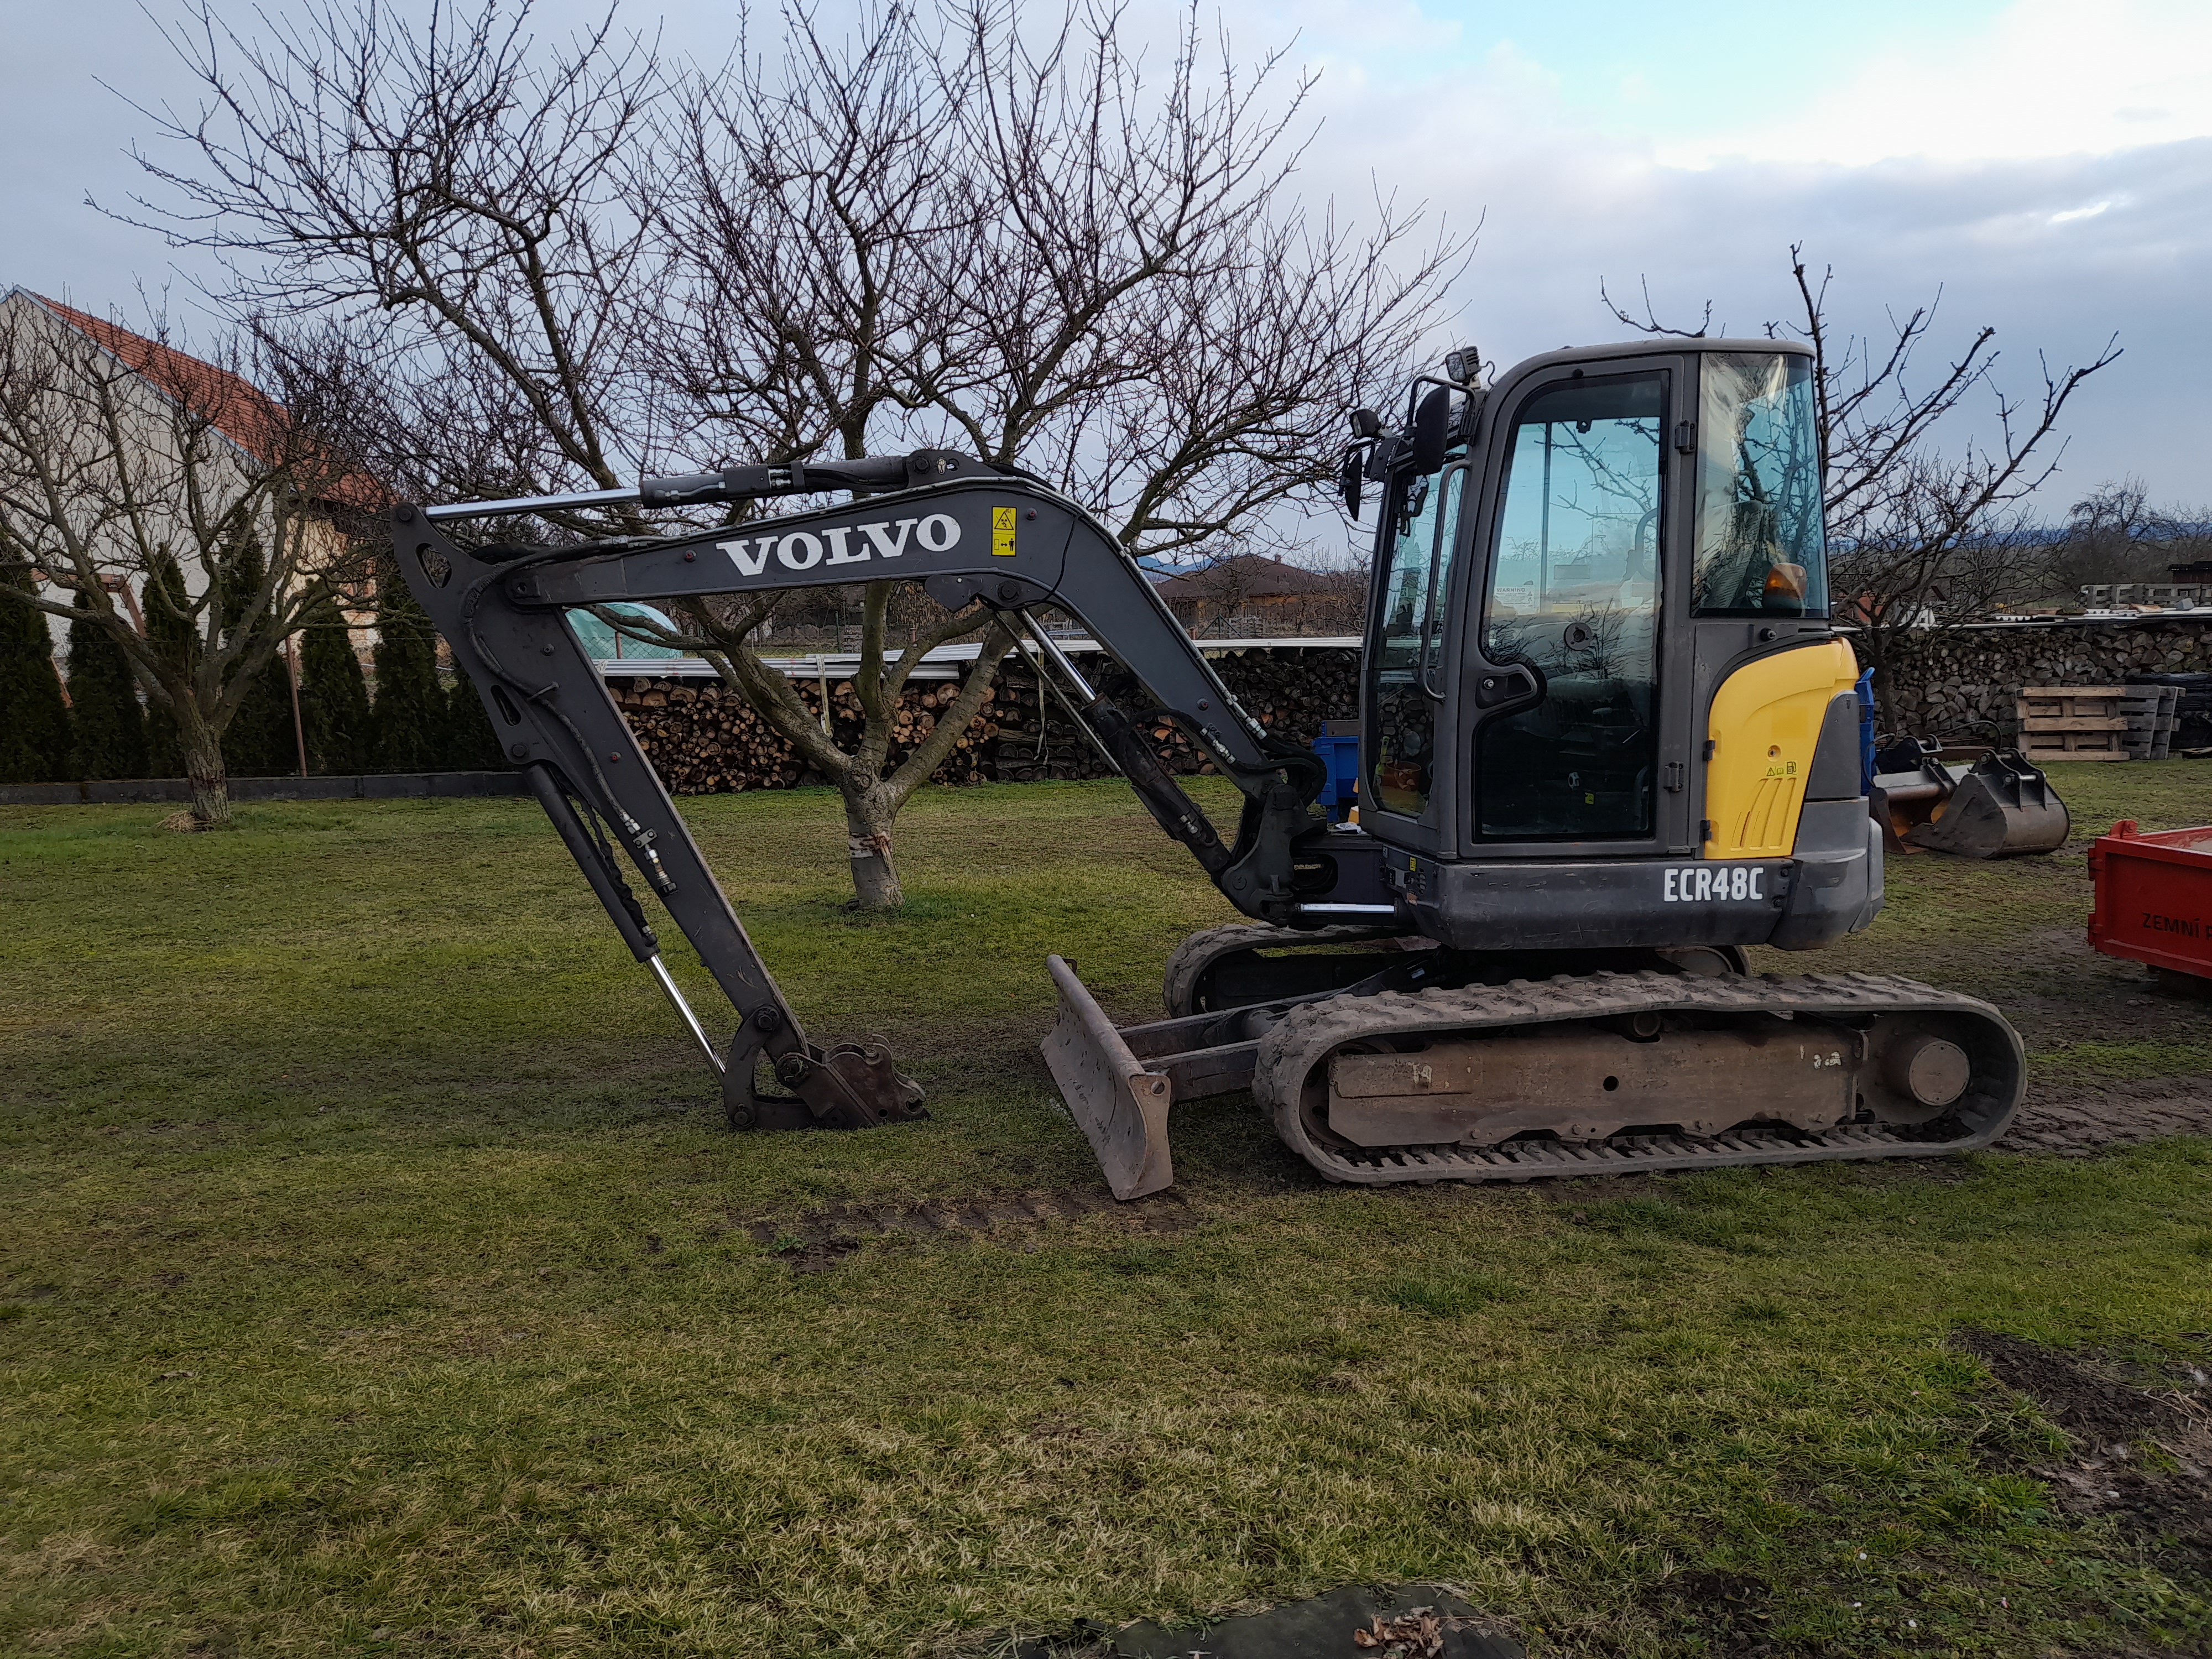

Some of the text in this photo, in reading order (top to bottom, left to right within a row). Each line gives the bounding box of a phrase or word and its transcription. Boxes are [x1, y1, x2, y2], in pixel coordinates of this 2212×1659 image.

[716, 513, 961, 577] VOLVO
[1663, 867, 1764, 902] ECR48C
[2142, 912, 2200, 938] ZEMNÍ
